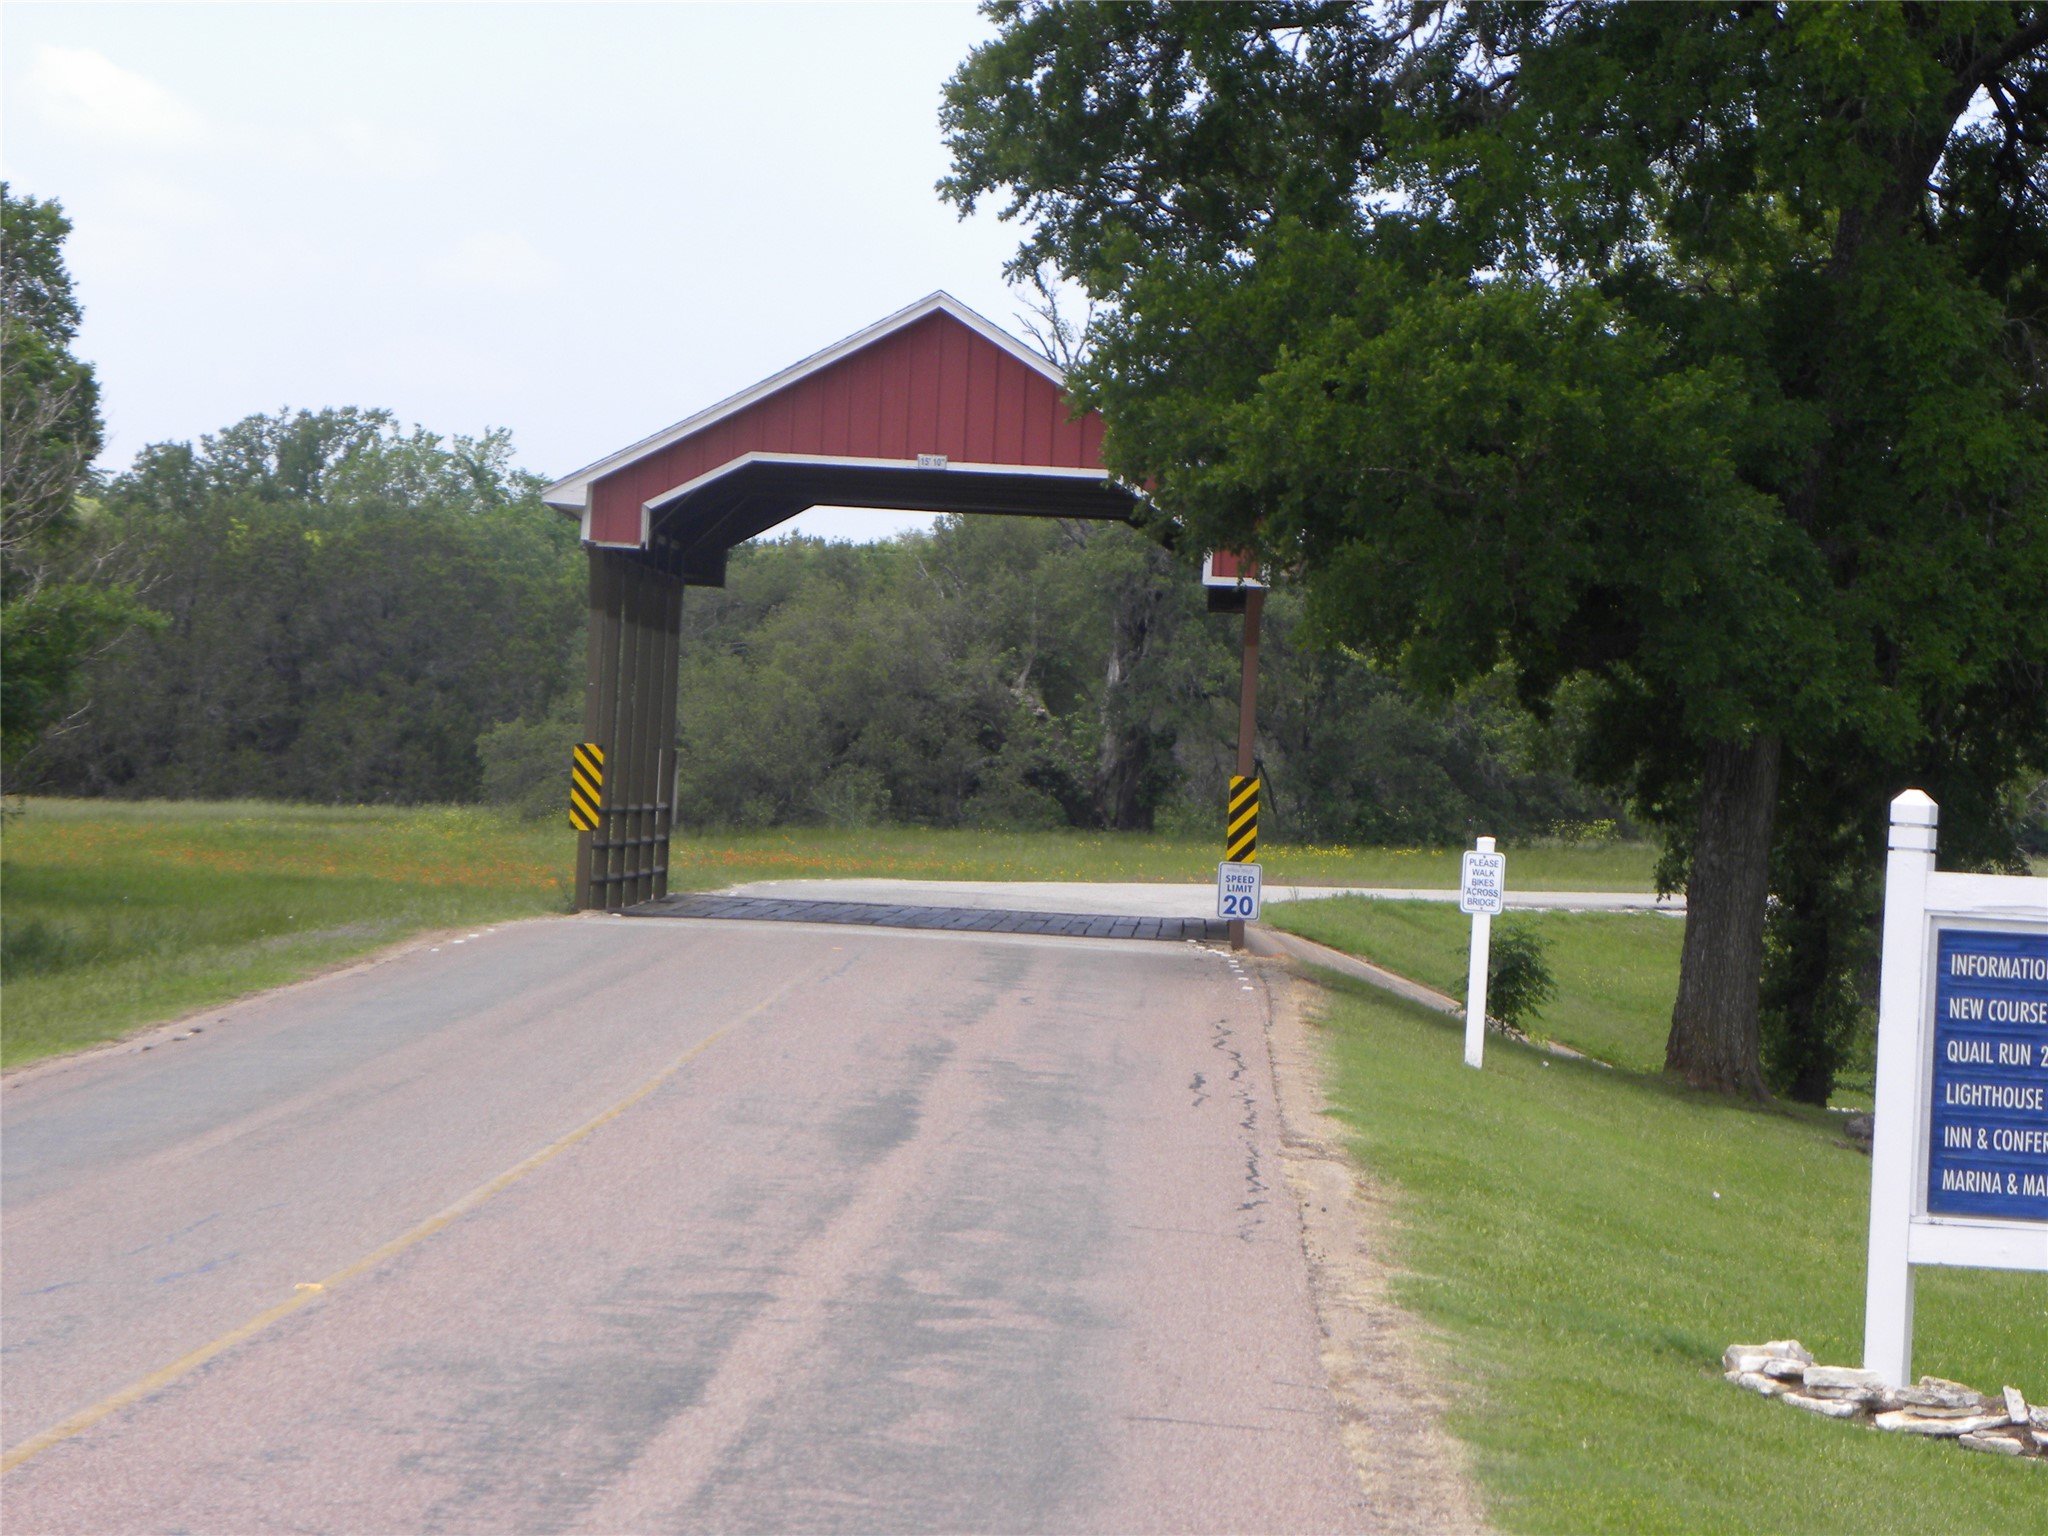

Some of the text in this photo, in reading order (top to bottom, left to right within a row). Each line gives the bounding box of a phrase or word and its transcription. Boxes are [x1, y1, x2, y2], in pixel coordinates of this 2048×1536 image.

[1469, 858, 1499, 868] PLEASE
[1225, 875, 1255, 884] SPEED
[1472, 869, 1495, 877] WALK
[1227, 884, 1253, 893] LIMIT
[1471, 878, 1494, 887] BIKES
[1466, 888, 1498, 898] ACROSS
[1223, 894, 1253, 916] 20
[1467, 897, 1496, 907] BRIDGE
[1951, 954, 2048, 980] INFORMATIO
[1949, 998, 2047, 1024] NEW COURSE
[1947, 1040, 1994, 1064] QUAIL
[1999, 1043, 2031, 1066] RUN
[1946, 1083, 2043, 1110] LIGHTHOUSE
[1944, 1126, 1972, 1149] INN
[1977, 1128, 1988, 1150] &
[1942, 1169, 2048, 1197] MARINA & MA
